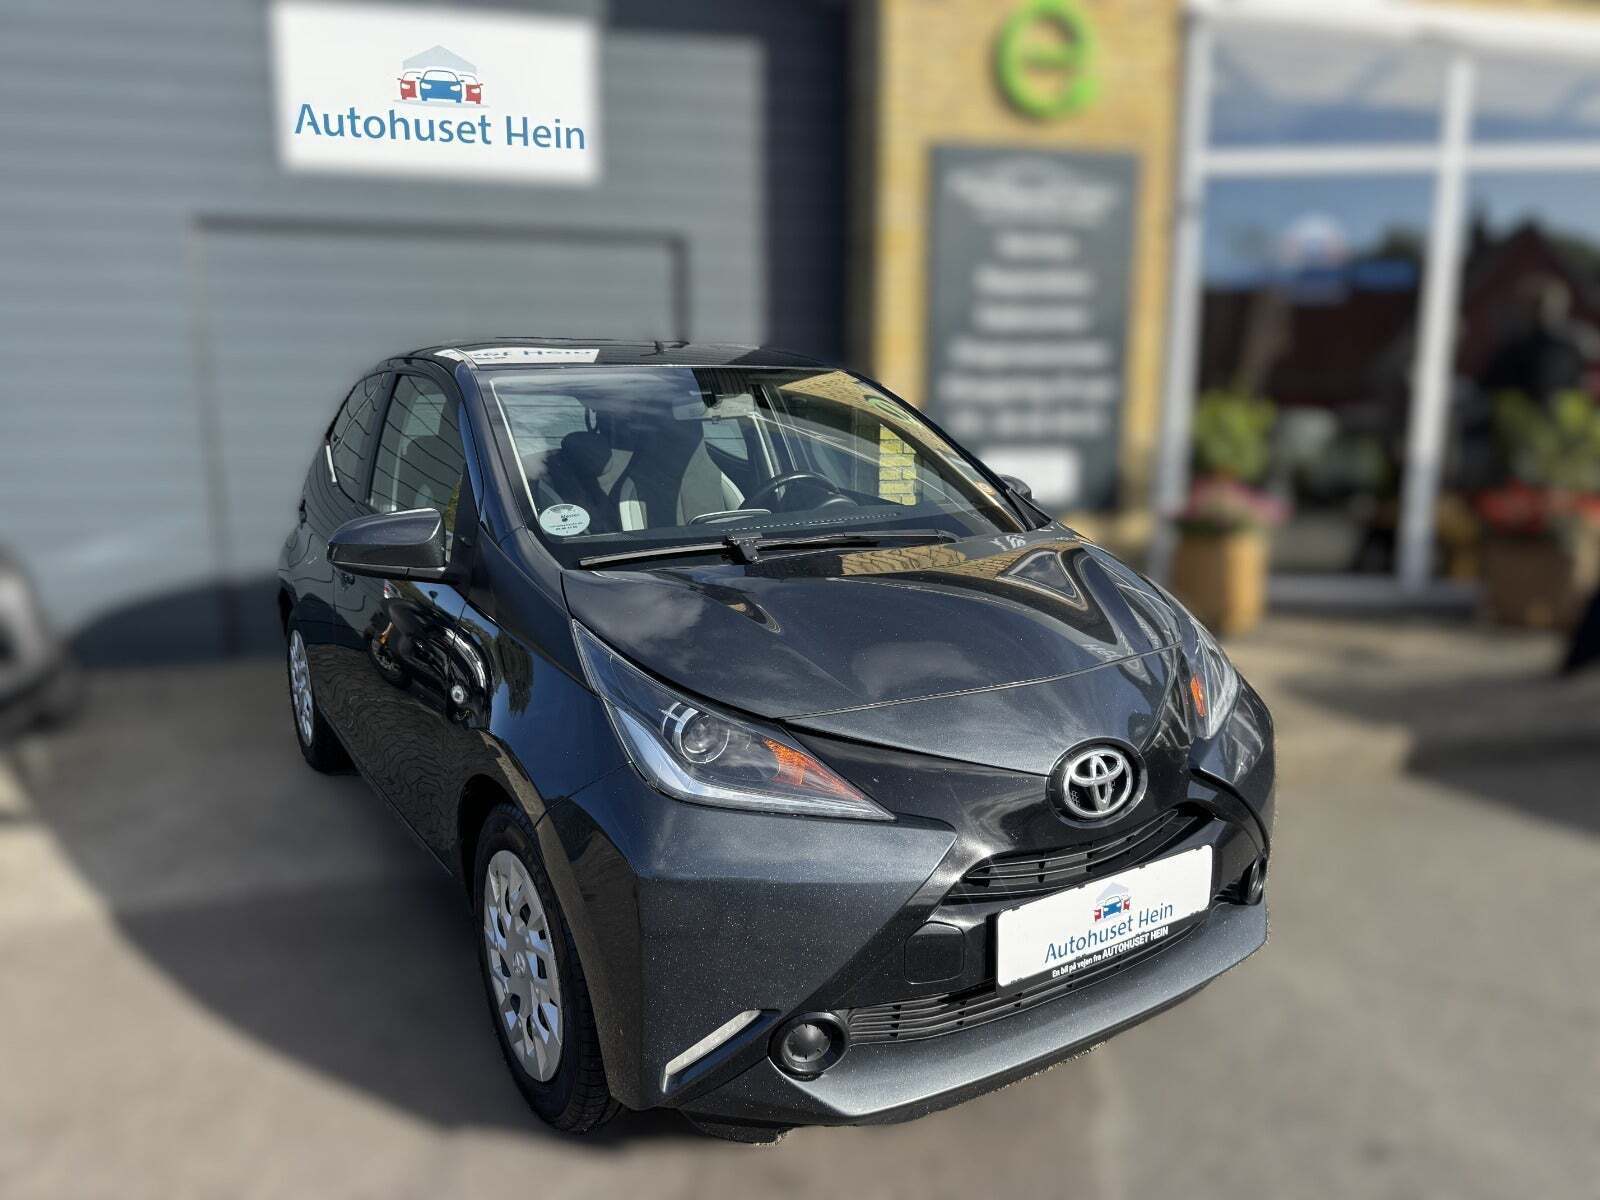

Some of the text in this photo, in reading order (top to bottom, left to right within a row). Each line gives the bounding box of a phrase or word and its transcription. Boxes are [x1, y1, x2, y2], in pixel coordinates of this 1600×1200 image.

[294, 103, 585, 149] Autohuset Hein
[1044, 902, 1173, 963] Autohuset Hein
[1102, 933, 1150, 960] AUTOHUSET
[1150, 926, 1169, 941] HEIN
